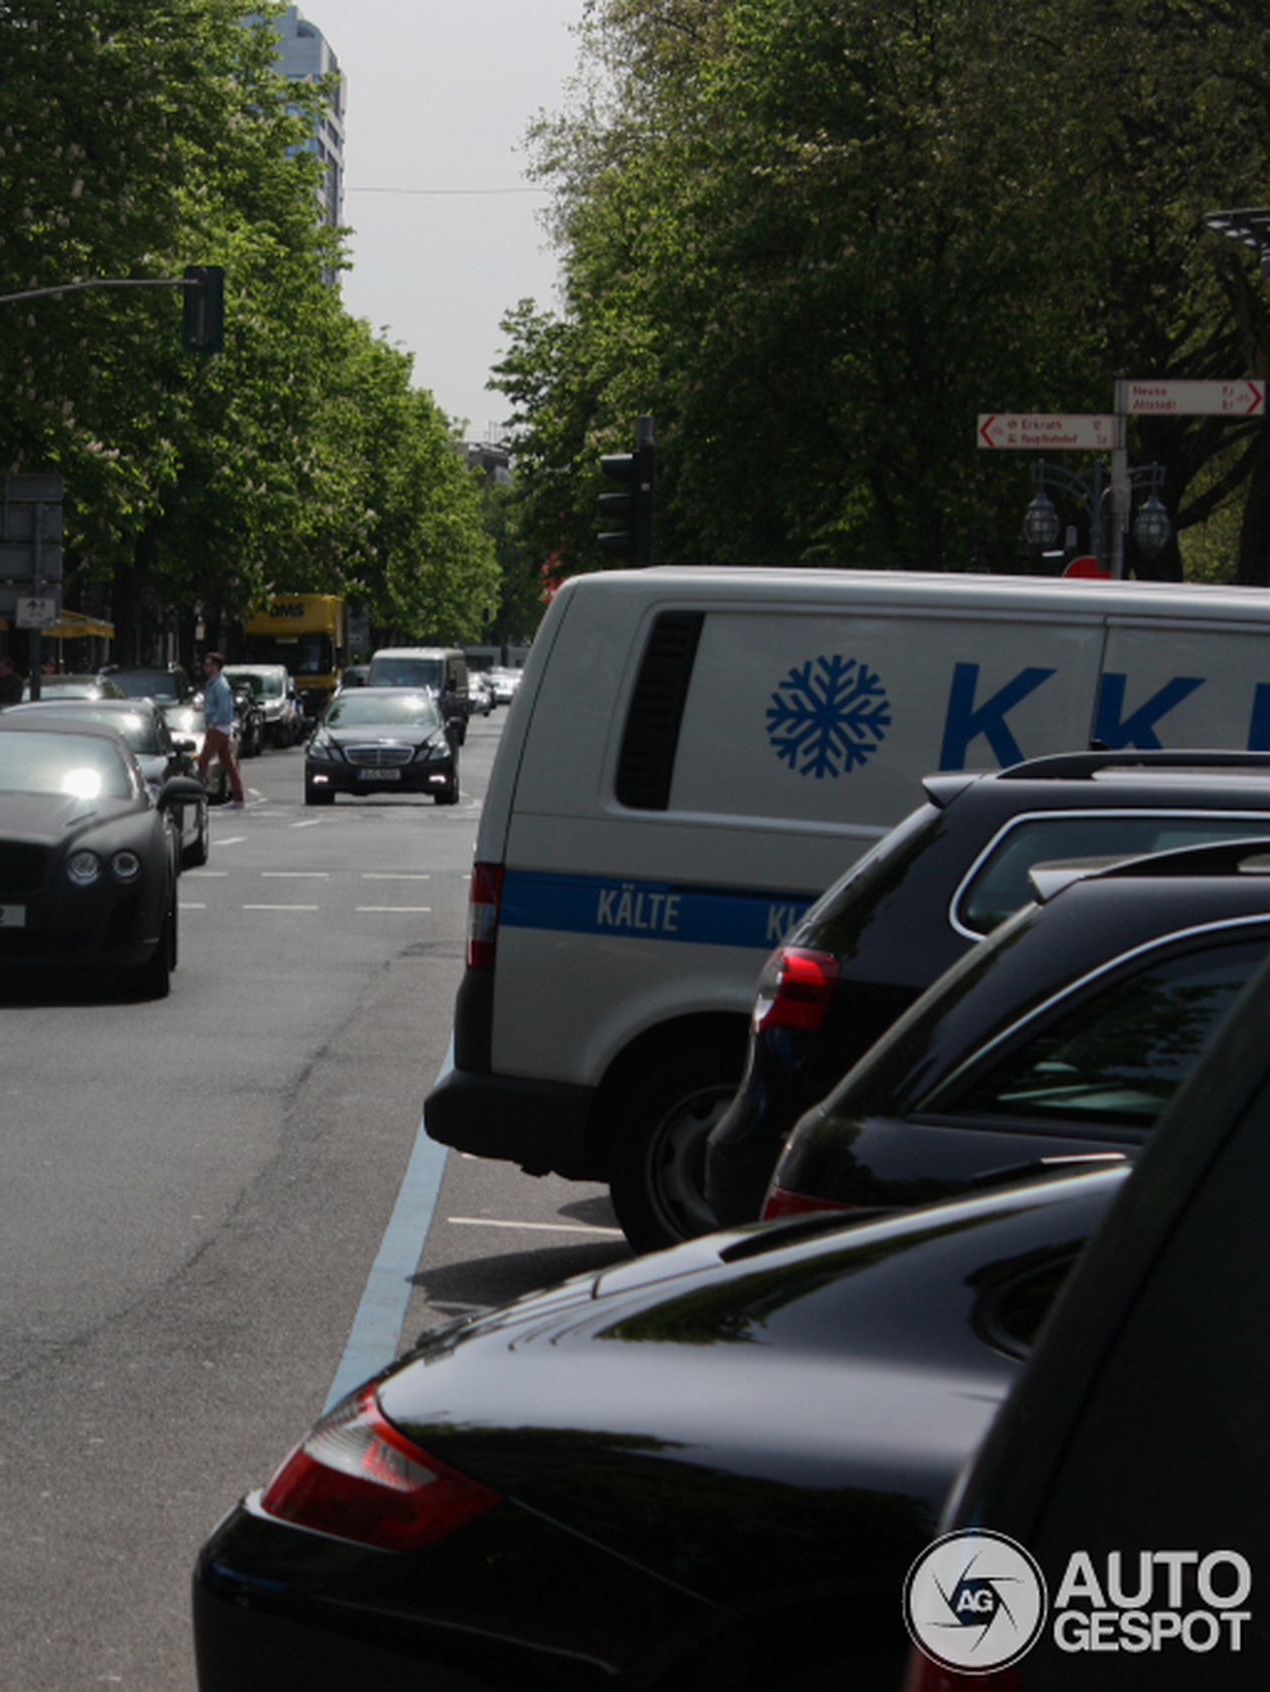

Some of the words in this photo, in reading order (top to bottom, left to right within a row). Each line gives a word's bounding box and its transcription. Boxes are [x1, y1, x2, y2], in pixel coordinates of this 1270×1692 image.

[1133, 399, 1177, 409] Altstadt
[1021, 419, 1062, 430] Erkrath
[596, 883, 682, 932] KÄLTE
